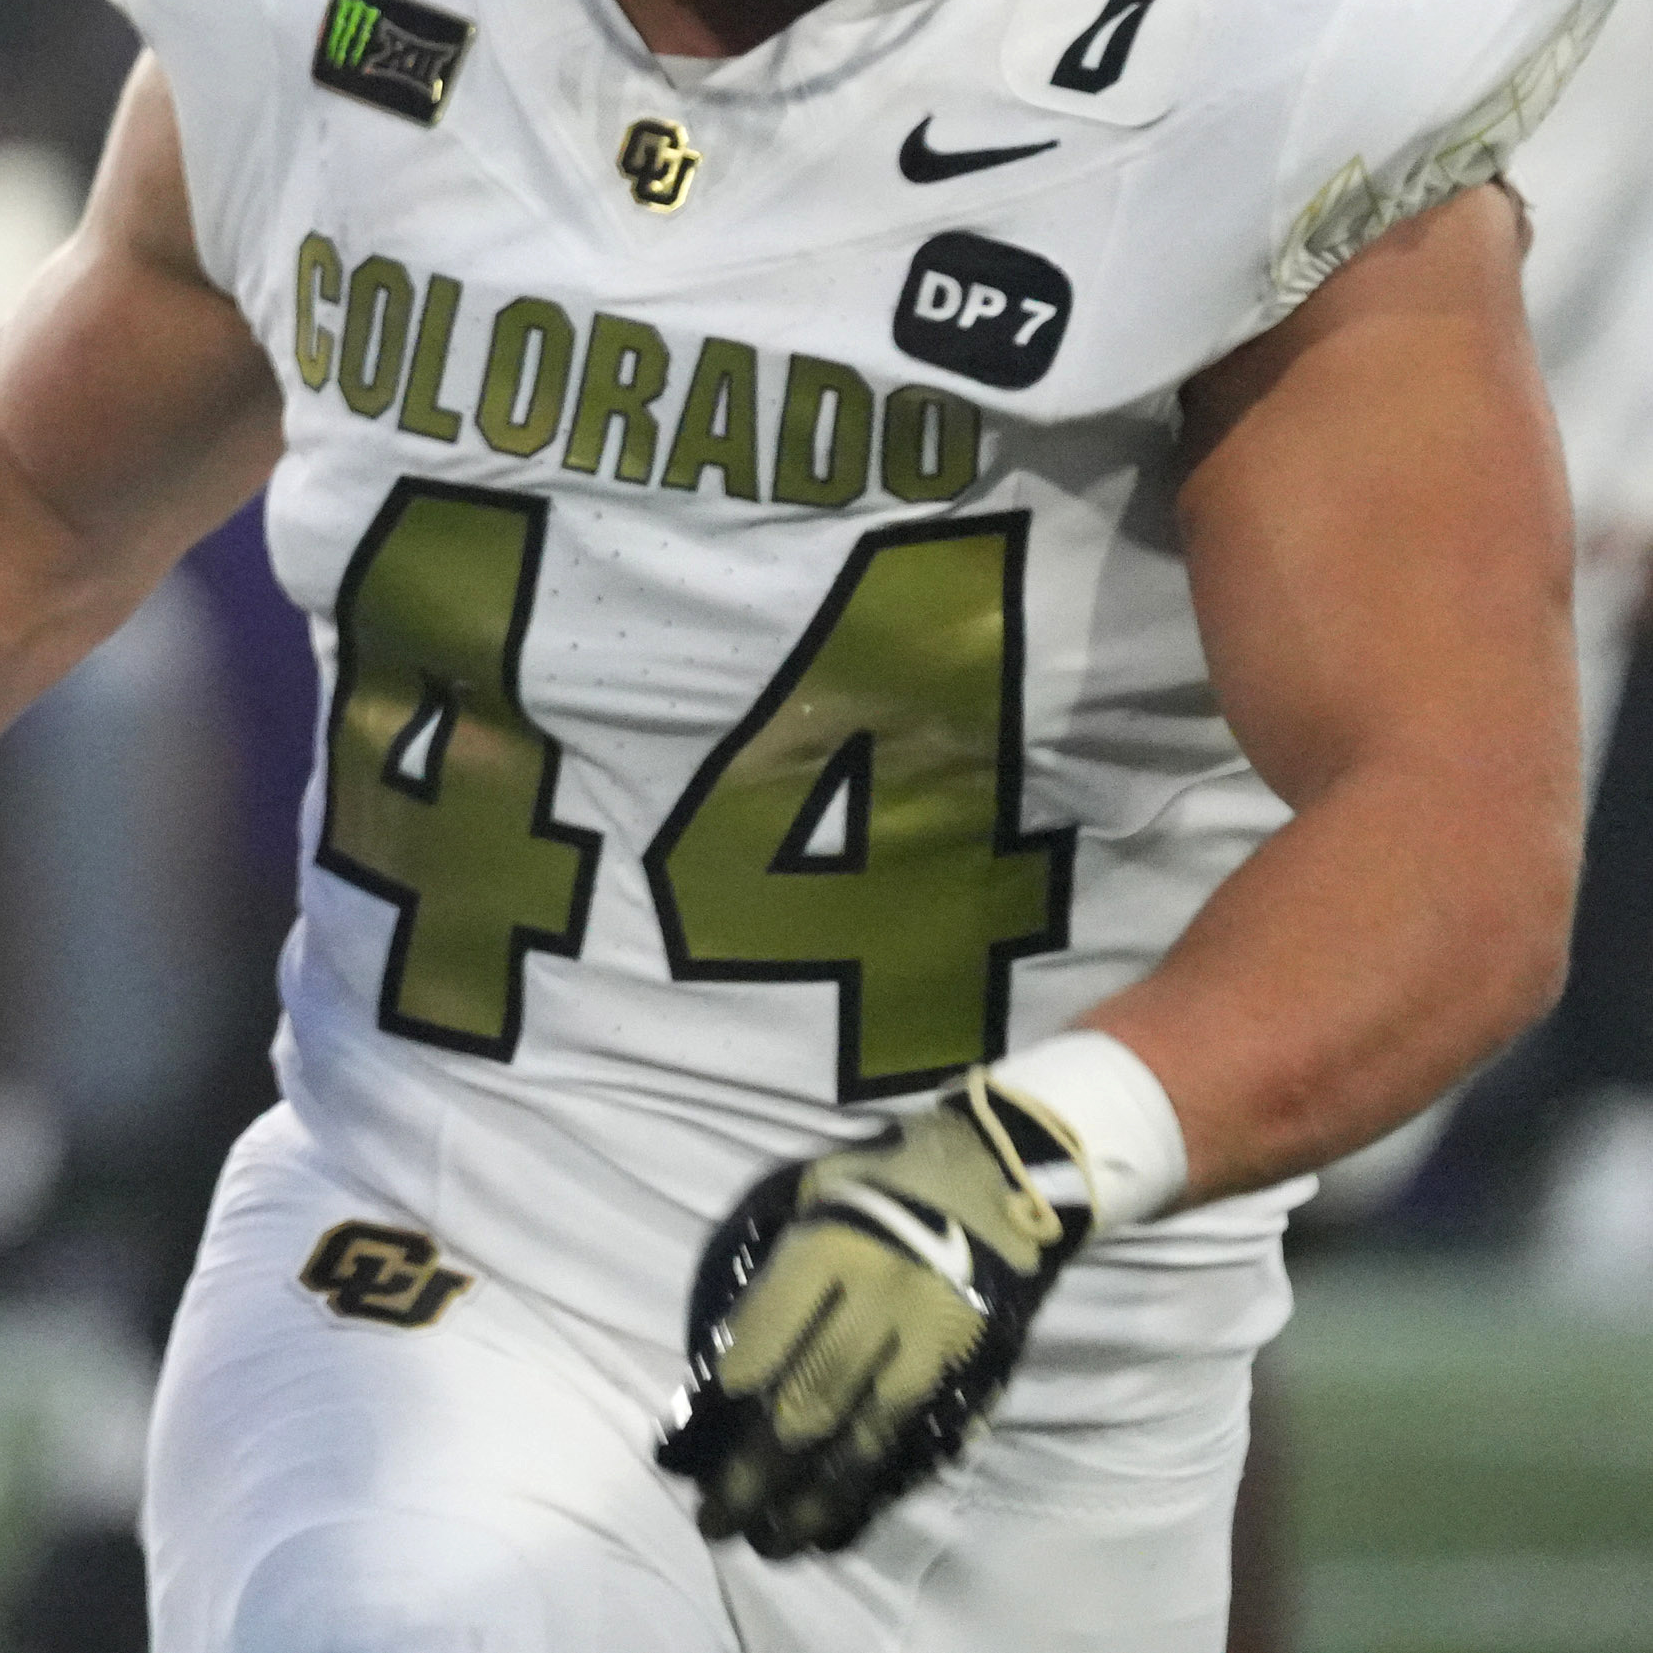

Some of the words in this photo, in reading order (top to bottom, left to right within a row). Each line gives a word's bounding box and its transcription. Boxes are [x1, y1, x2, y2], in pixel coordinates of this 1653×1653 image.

[294, 230, 982, 509] COLORADO
[914, 269, 1007, 329] DP
[1014, 297, 1058, 347] 7
[315, 475, 1078, 1105] 44
